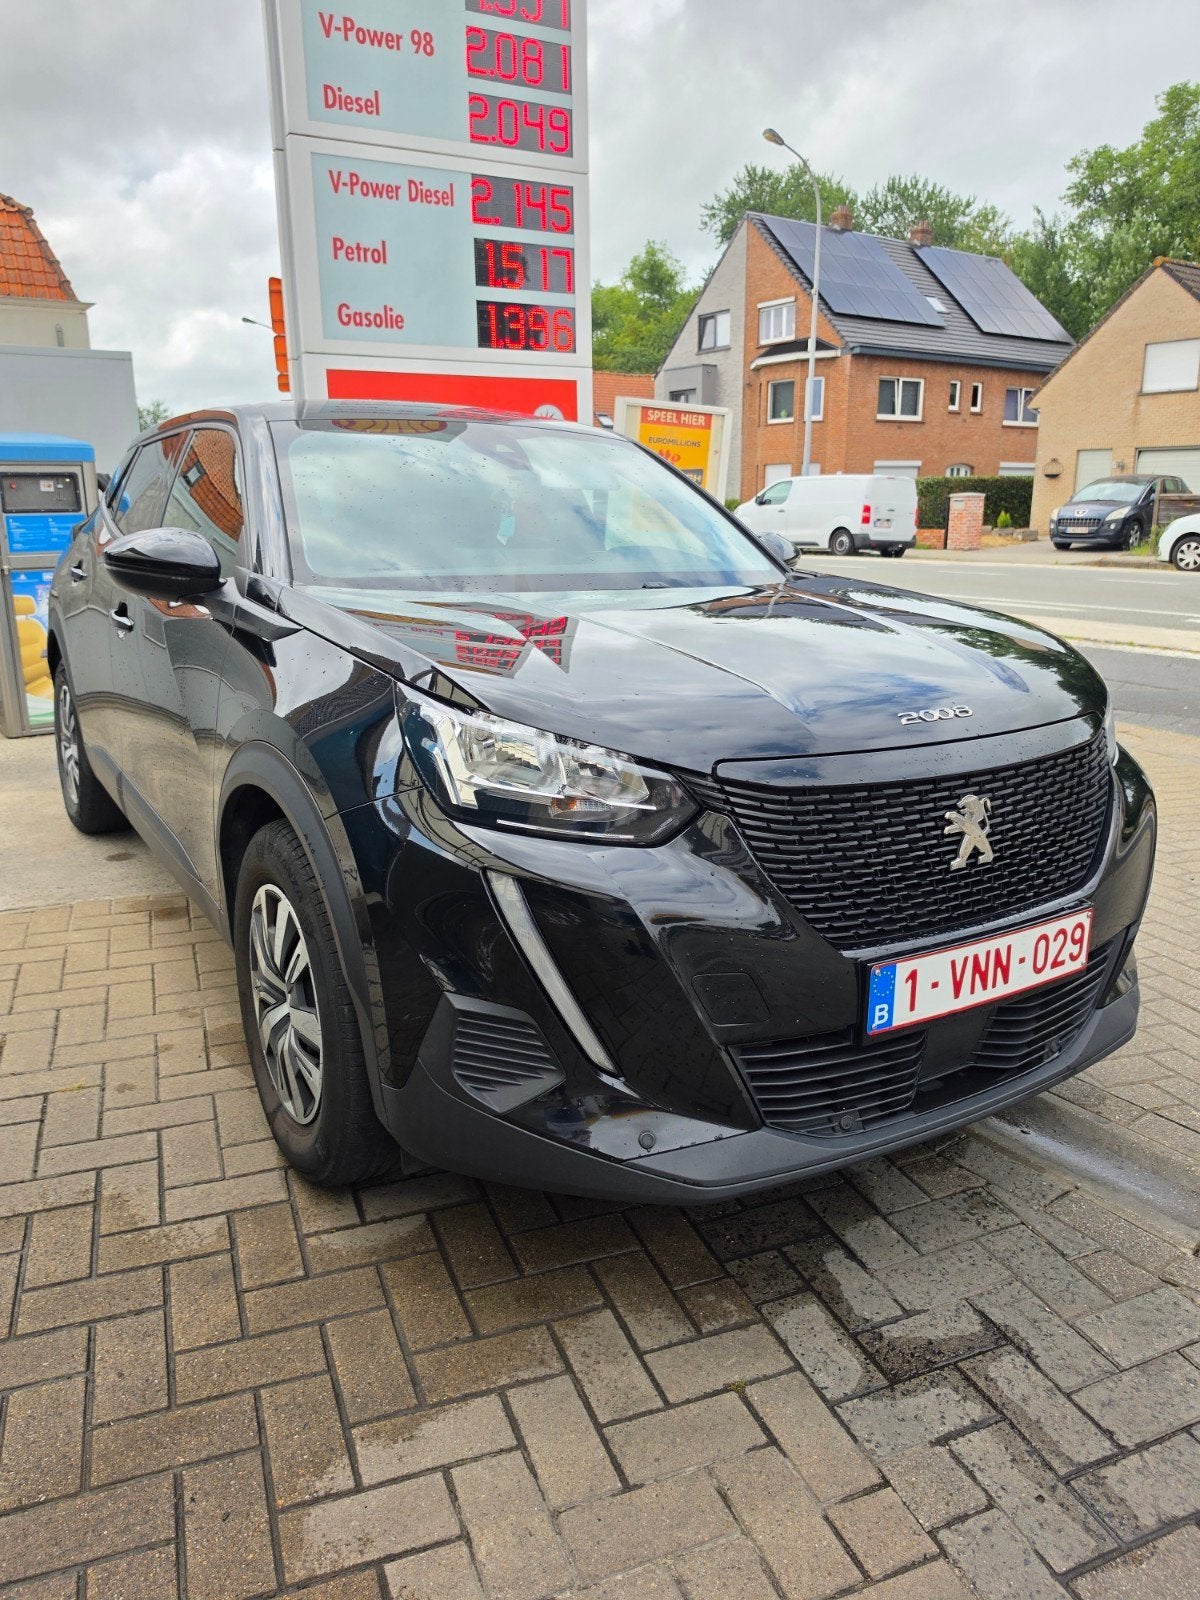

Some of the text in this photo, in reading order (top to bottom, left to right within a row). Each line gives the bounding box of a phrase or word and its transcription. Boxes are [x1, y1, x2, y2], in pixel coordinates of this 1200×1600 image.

[318, 11, 435, 57] V-Power 98
[465, 26, 568, 91] 2.081
[323, 84, 380, 116] Diesel
[468, 95, 569, 154] 2.049
[328, 170, 454, 207] V-Power Diesel
[471, 178, 571, 233] 2.145
[332, 236, 387, 264] Petrol
[485, 241, 573, 293] 1.517
[337, 303, 404, 329] Gasolie
[488, 303, 573, 352] 1.396
[647, 410, 705, 426] SPEEL HIER
[648, 436, 701, 448] EUROMILLIONS
[897, 705, 973, 725] 2008
[904, 921, 1087, 1013] 1-VNN-029
[873, 1003, 889, 1026] B
